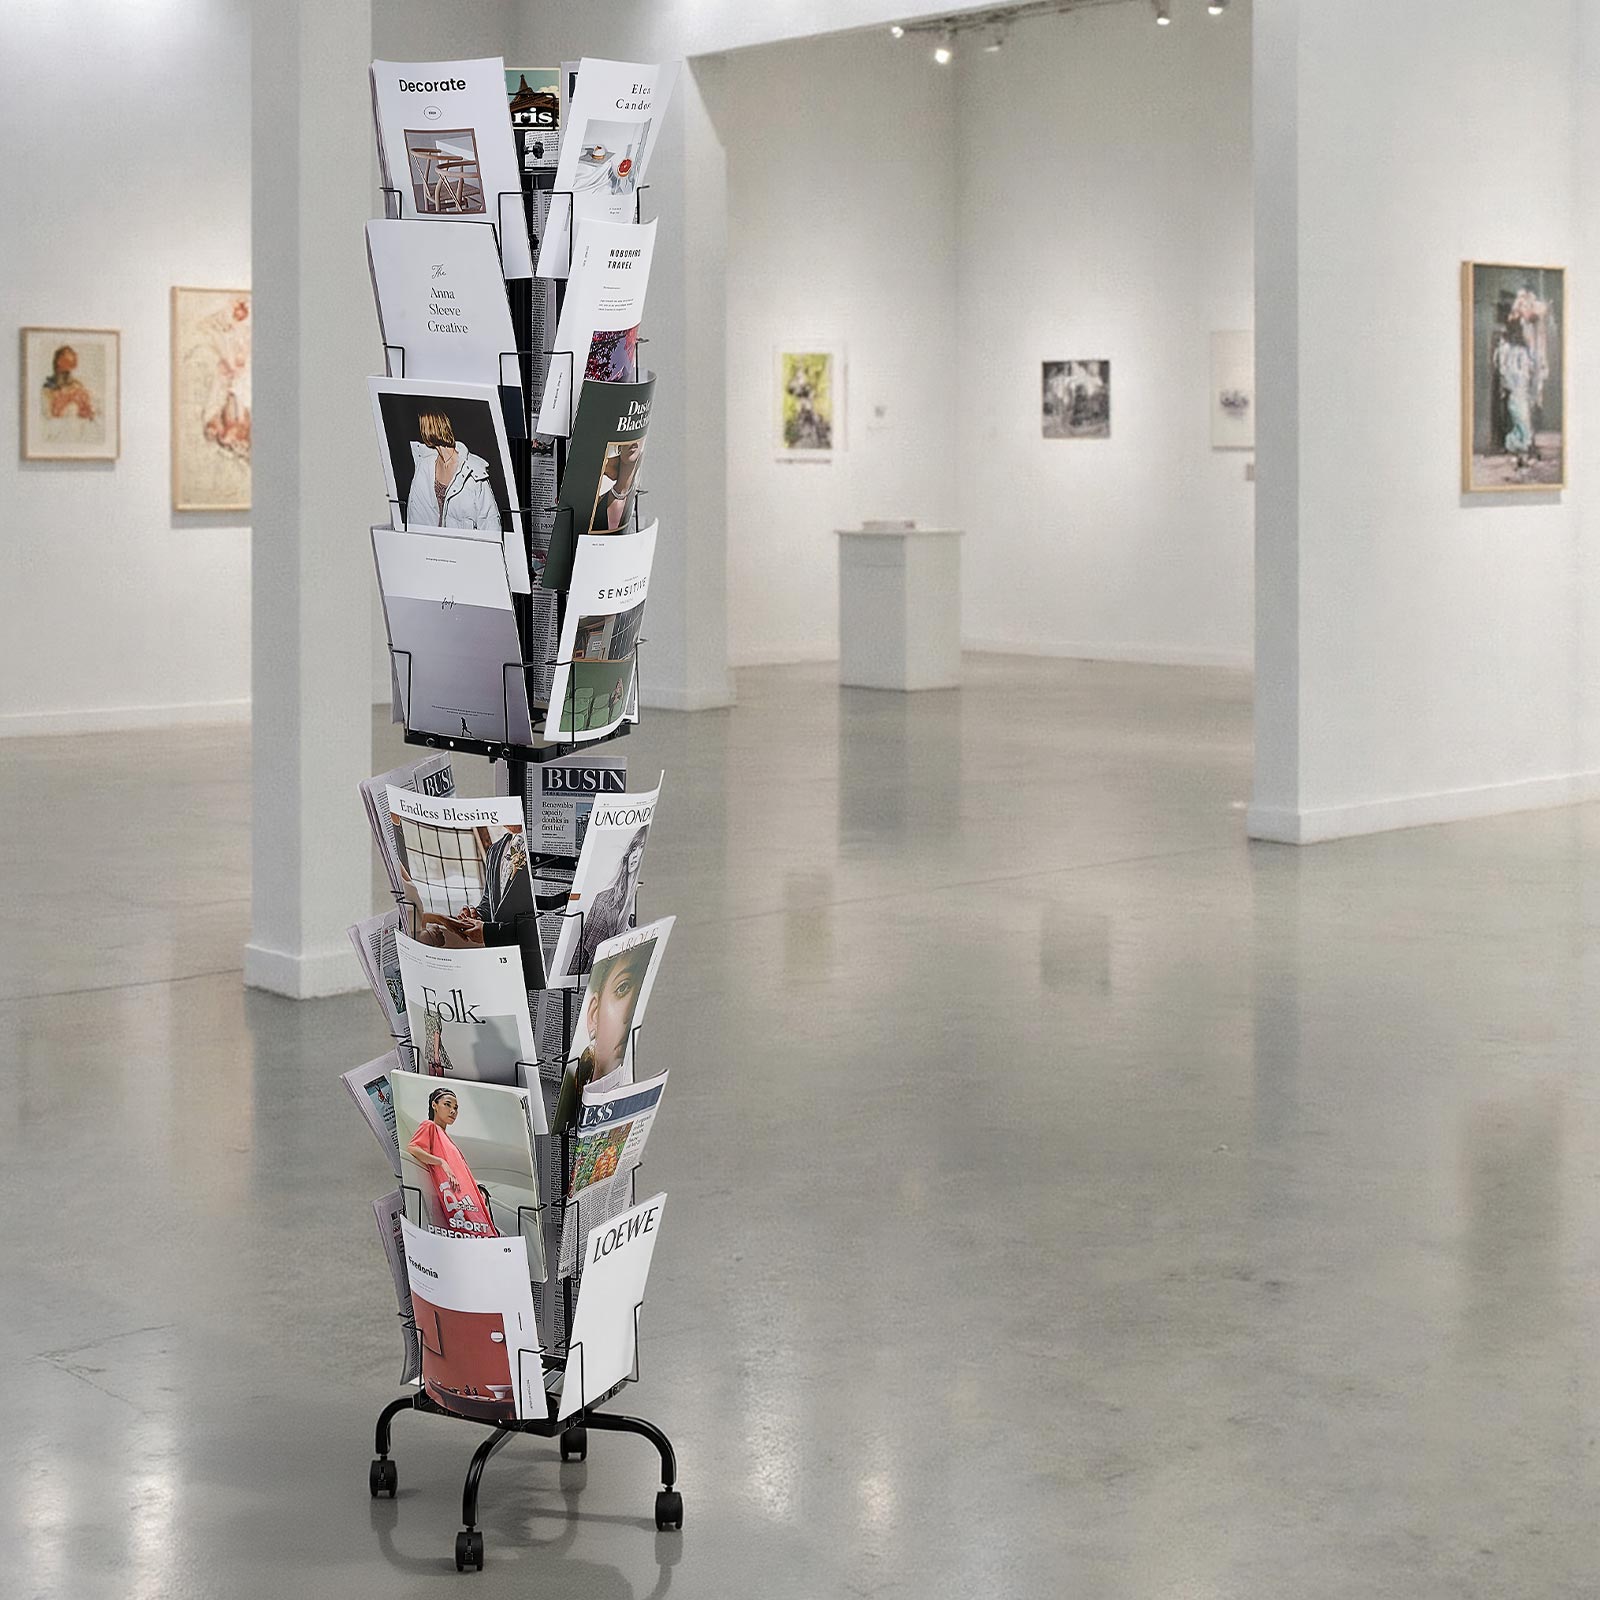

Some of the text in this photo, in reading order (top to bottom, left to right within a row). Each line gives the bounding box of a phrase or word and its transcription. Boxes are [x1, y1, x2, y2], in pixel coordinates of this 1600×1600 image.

[399, 78, 466, 92] Decorate
[431, 263, 447, 279] The
[608, 260, 632, 269] TRAVEL
[430, 287, 456, 299] Anna
[428, 303, 461, 316] Sleeve
[427, 319, 469, 333] Creative
[546, 768, 626, 791] BUSIN
[400, 799, 499, 824] Endless Blessing
[542, 801, 574, 810] Renewables
[541, 809, 563, 818] capacity
[541, 816, 563, 825] doubles
[541, 823, 553, 832] first
[498, 956, 508, 964] 13
[420, 985, 487, 1025] Folk.
[448, 1217, 490, 1234] SPORT
[592, 1206, 660, 1264] LOEWE
